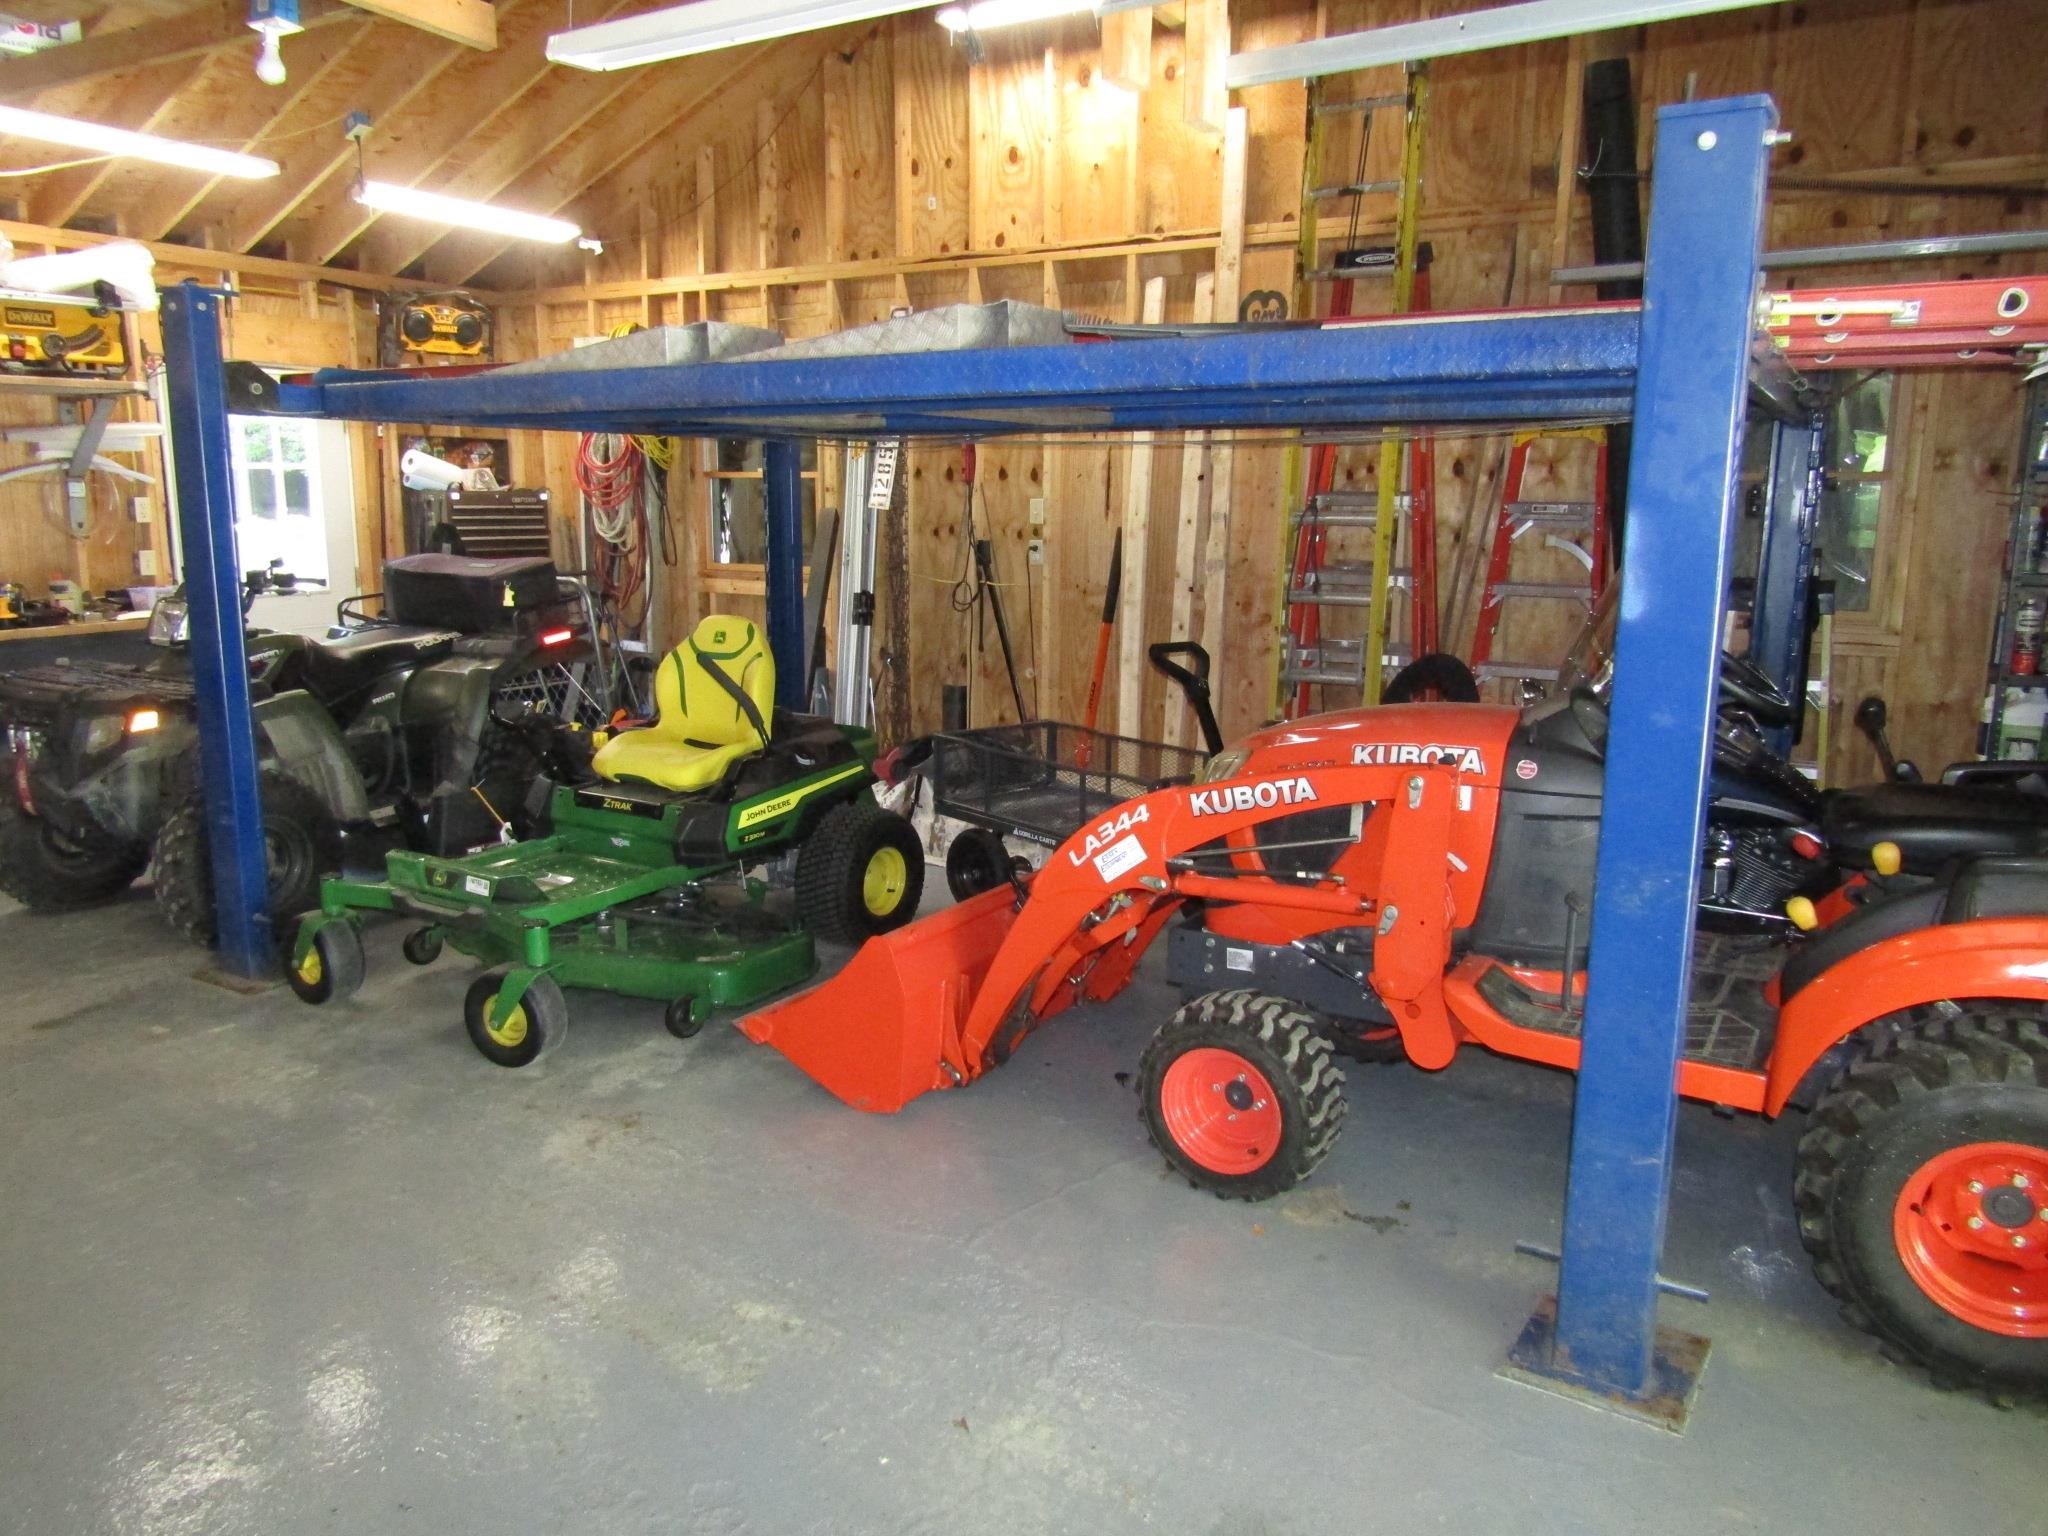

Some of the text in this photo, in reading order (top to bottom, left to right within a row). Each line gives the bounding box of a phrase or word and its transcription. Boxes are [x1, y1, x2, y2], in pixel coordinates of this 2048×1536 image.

[603, 798, 633, 811] ZTRAK
[745, 798, 792, 822] JOHN DEERE
[1188, 776, 1318, 818] KUBOTA
[1068, 803, 1150, 867] LA344
